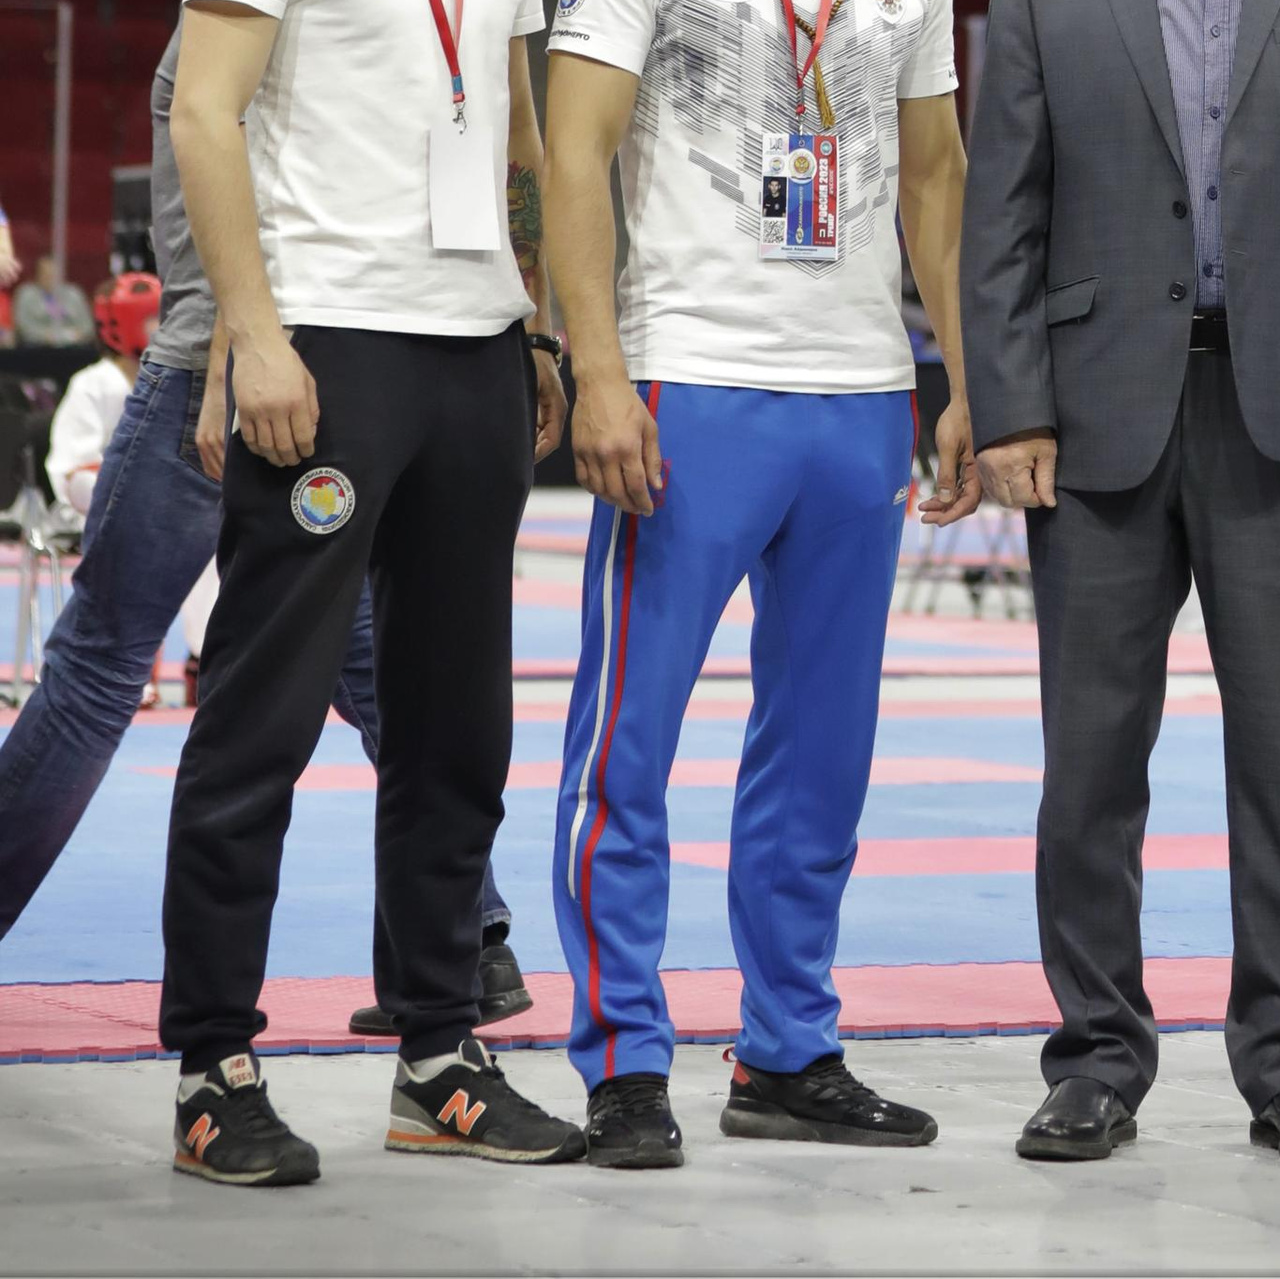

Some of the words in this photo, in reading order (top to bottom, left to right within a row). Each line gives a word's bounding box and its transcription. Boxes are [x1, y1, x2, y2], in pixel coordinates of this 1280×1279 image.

[818, 158, 829, 184] 2023
[818, 184, 829, 224] РОССИЯ
[436, 1088, 487, 1136] N
[186, 1112, 221, 1161] N
